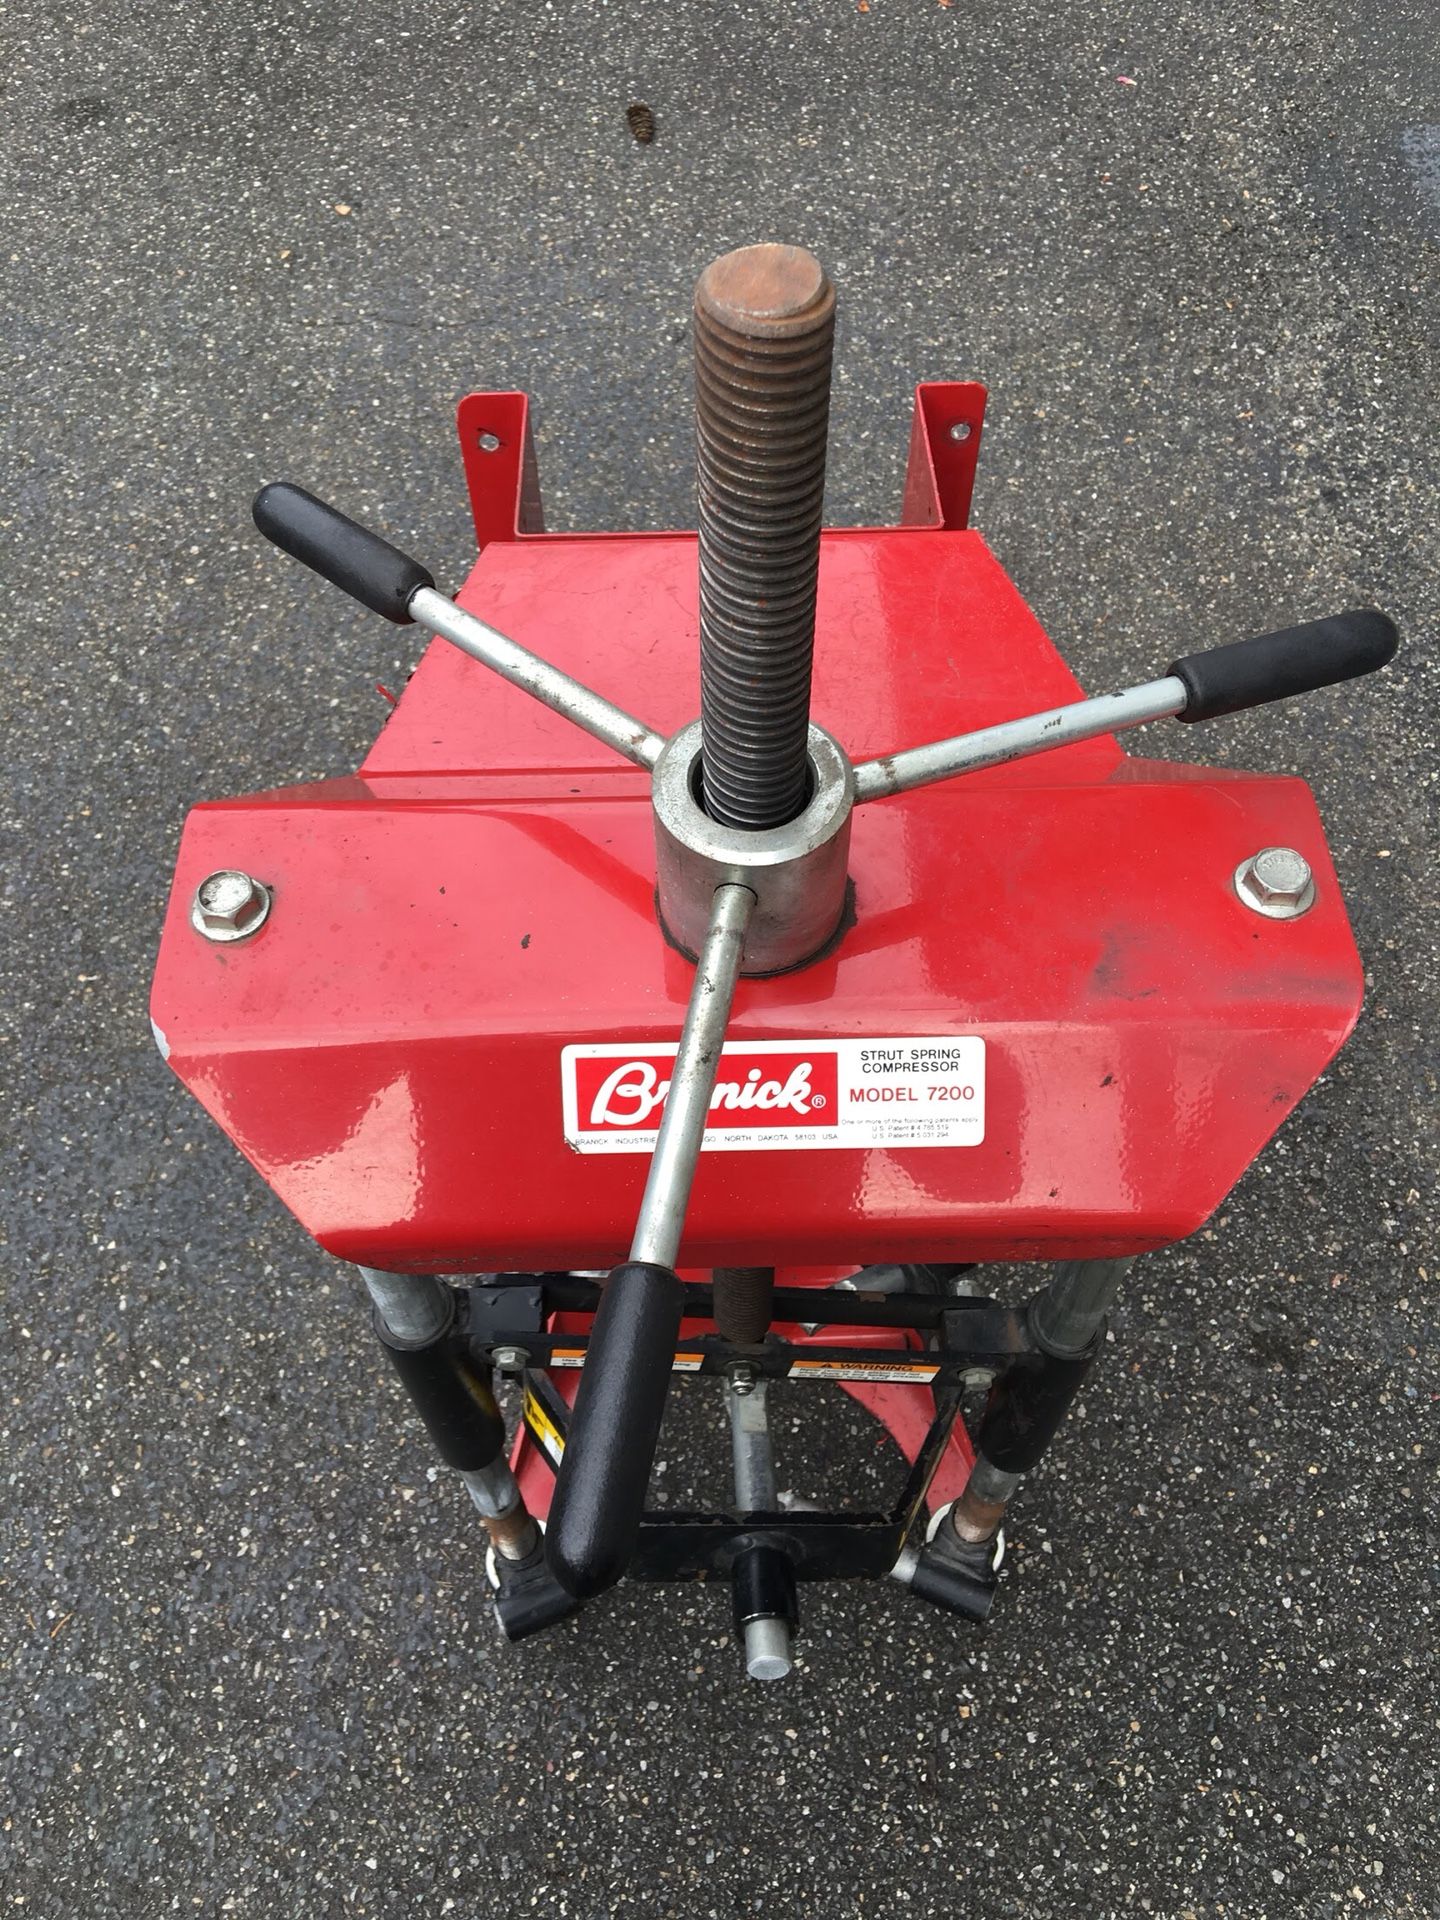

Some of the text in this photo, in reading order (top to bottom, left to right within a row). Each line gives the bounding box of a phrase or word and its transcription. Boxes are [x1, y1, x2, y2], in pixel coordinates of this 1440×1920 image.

[860, 1048, 961, 1061] STRUT SPRING
[862, 1061, 959, 1073] COMPRESSOR
[590, 1061, 812, 1126] Brnick
[849, 1085, 975, 1102] MODEL 7200
[575, 1138, 609, 1146] BRANICK
[615, 1136, 657, 1145] INDUSTRIE
[724, 1134, 752, 1142] NORTH
[758, 1134, 789, 1142] DAKOTA
[795, 1133, 816, 1141] 58103
[822, 1132, 839, 1141] USA
[840, 1363, 914, 1371] WARNING
